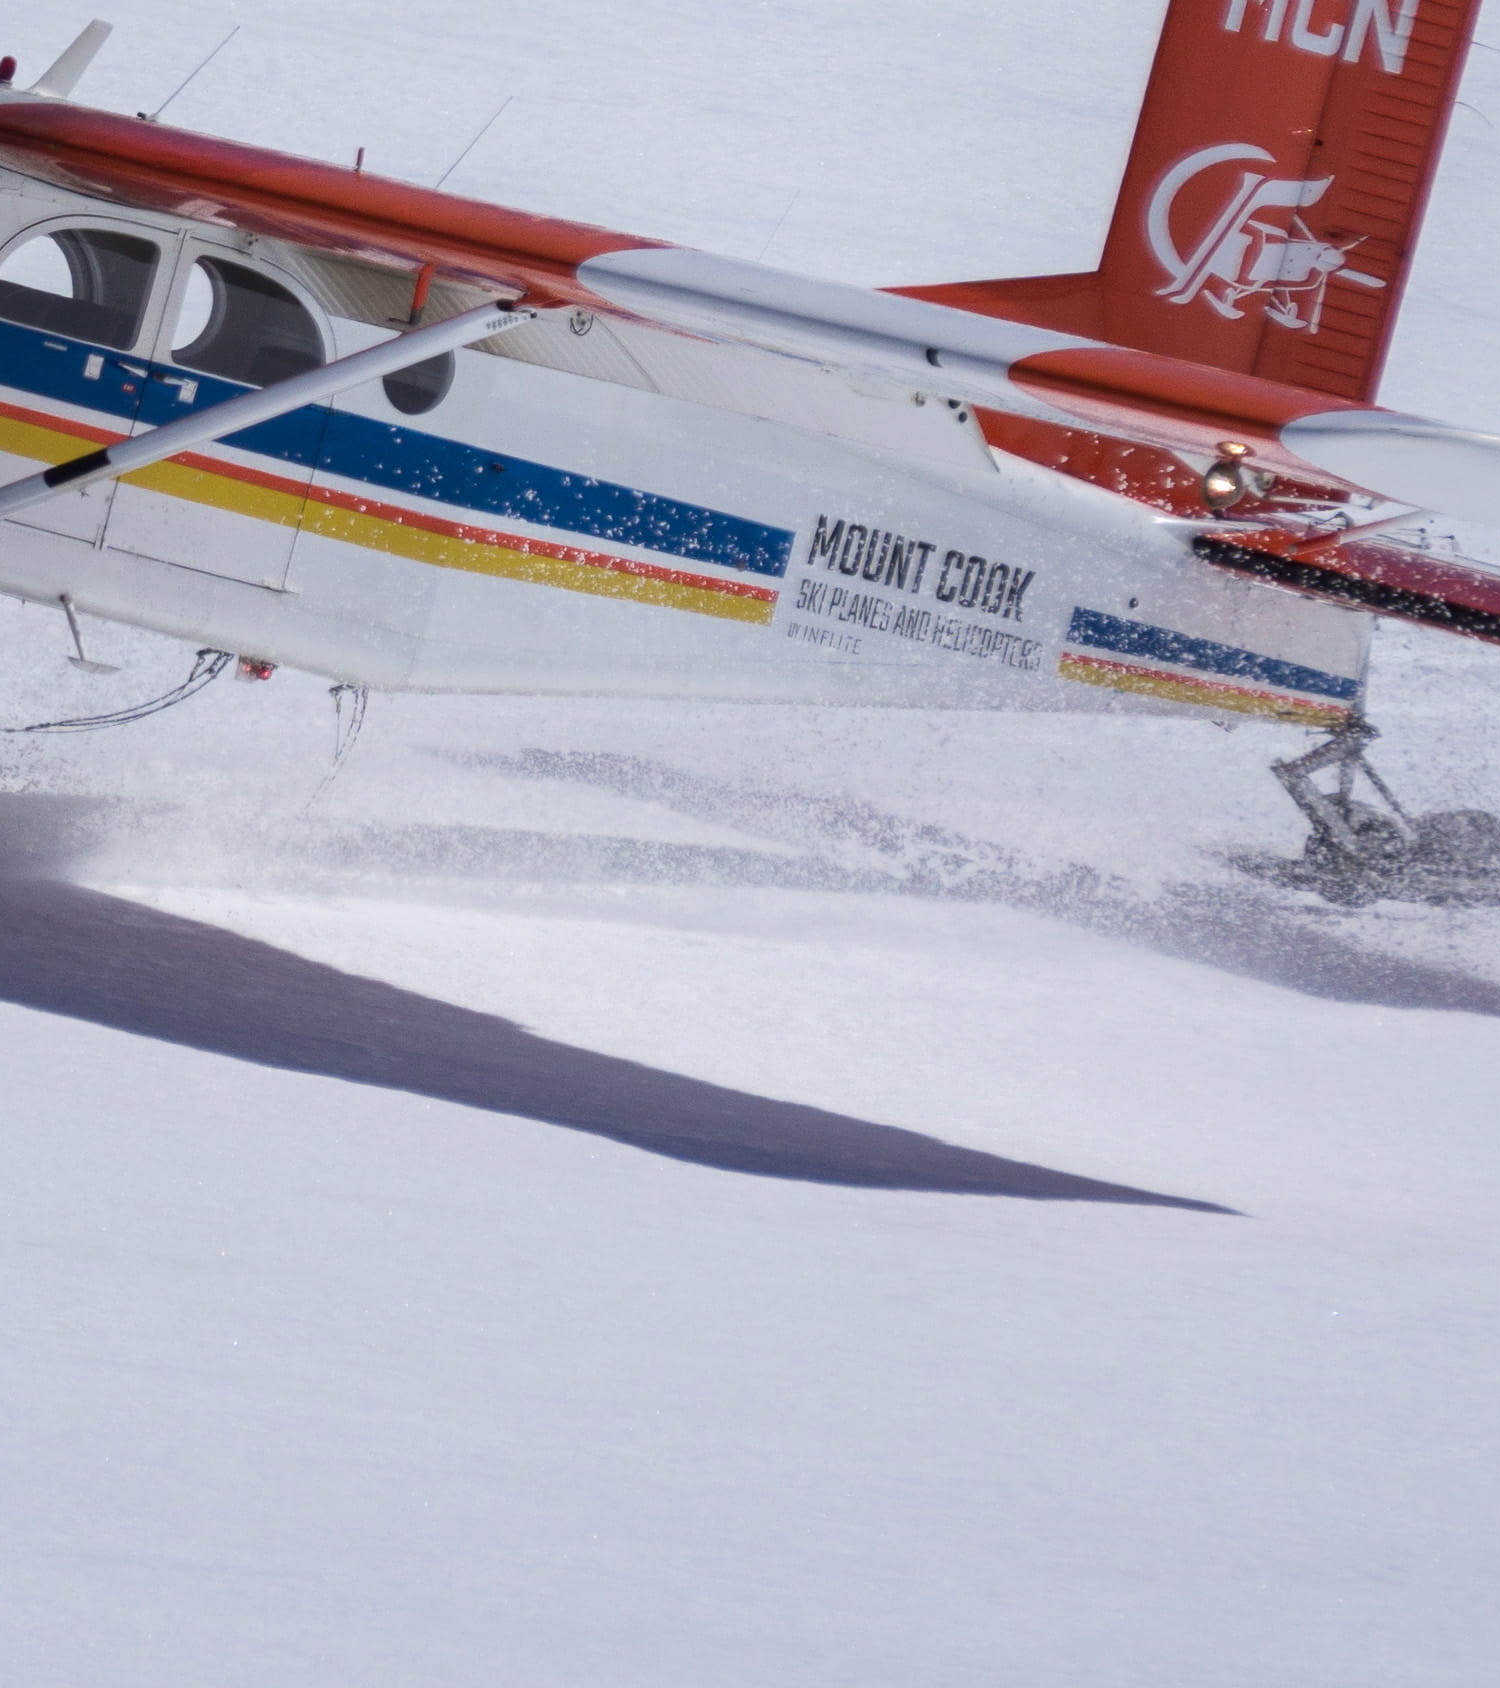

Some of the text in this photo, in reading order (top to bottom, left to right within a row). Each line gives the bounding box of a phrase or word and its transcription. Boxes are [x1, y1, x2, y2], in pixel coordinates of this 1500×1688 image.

[807, 514, 1036, 622] MOUNT COOK
[797, 578, 1044, 672] SKI PLANES AND HELICOPTERS
[803, 625, 864, 656] INFLITE
